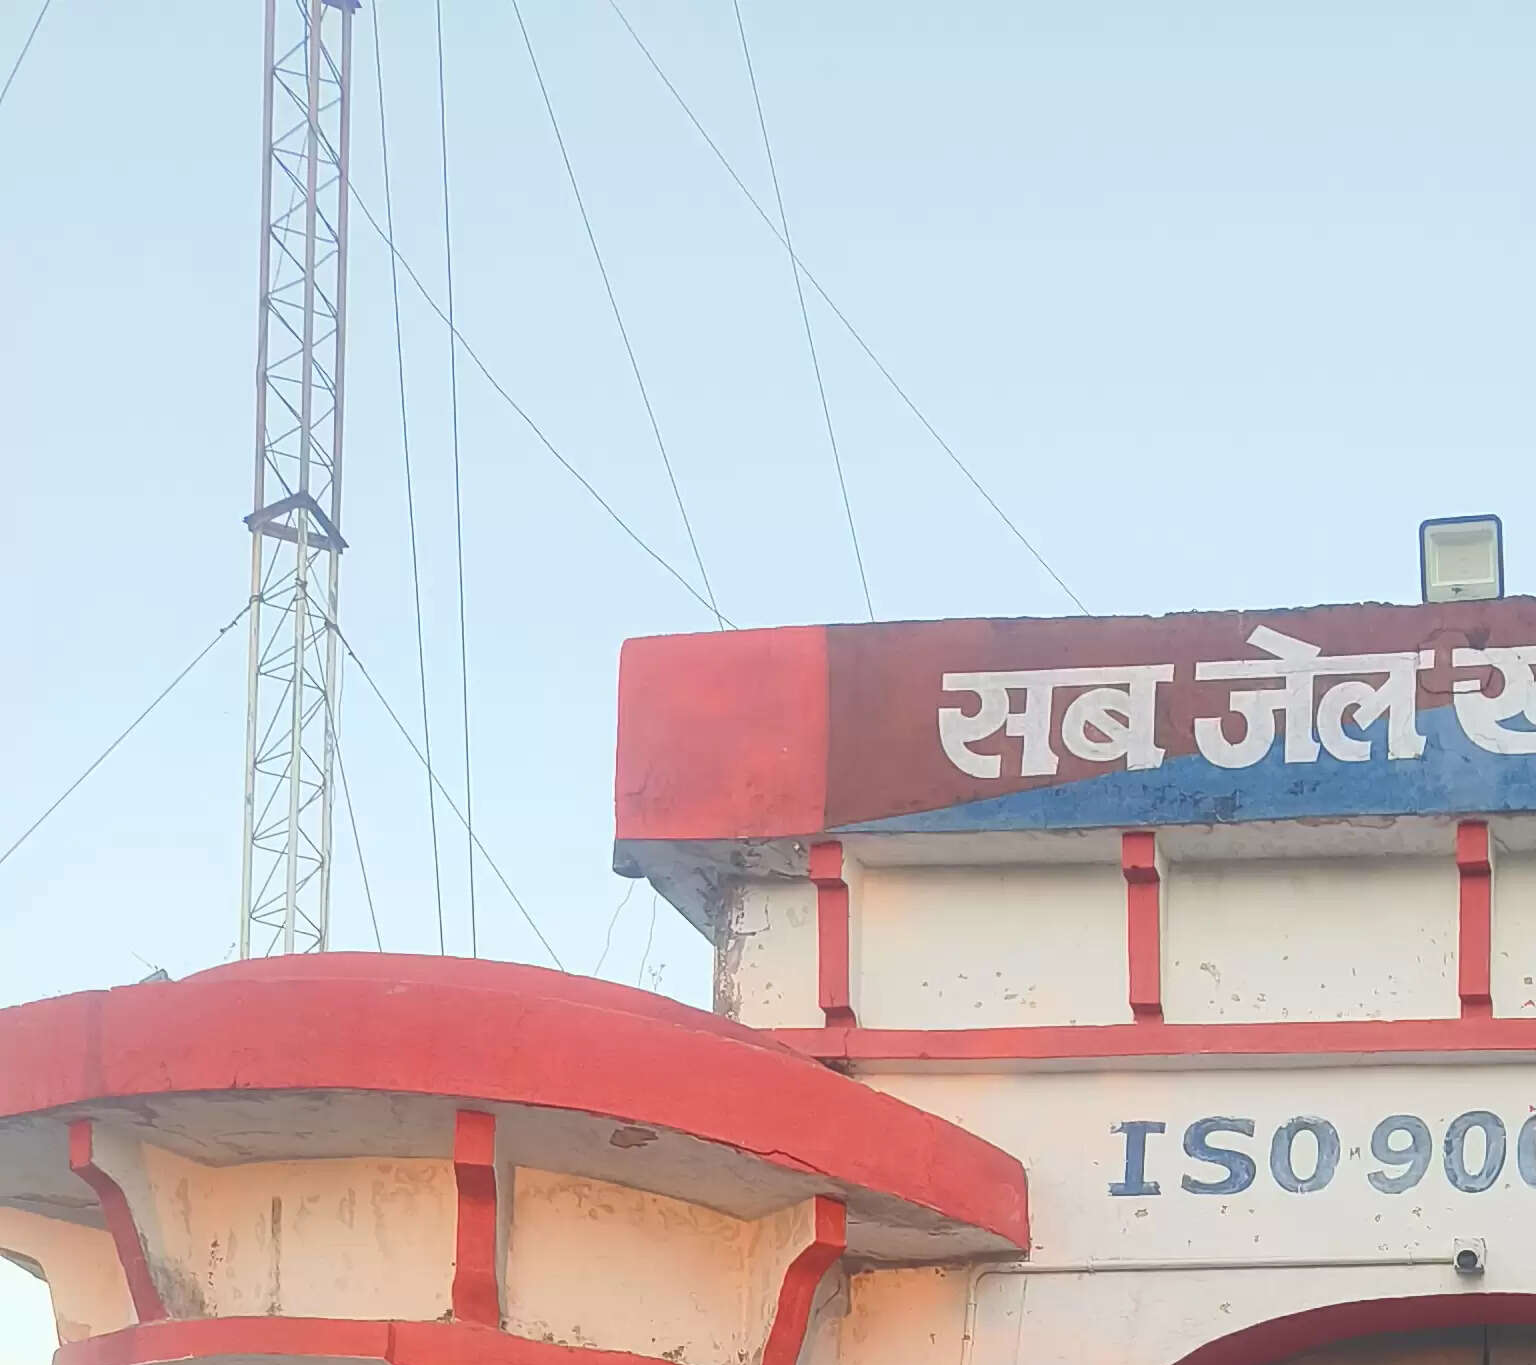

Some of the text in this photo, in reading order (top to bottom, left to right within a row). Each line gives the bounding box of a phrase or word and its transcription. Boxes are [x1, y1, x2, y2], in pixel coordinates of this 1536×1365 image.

[938, 662, 1176, 779] सब
[1193, 624, 1436, 770] जेल
[1108, 1115, 1341, 1197] ISO
